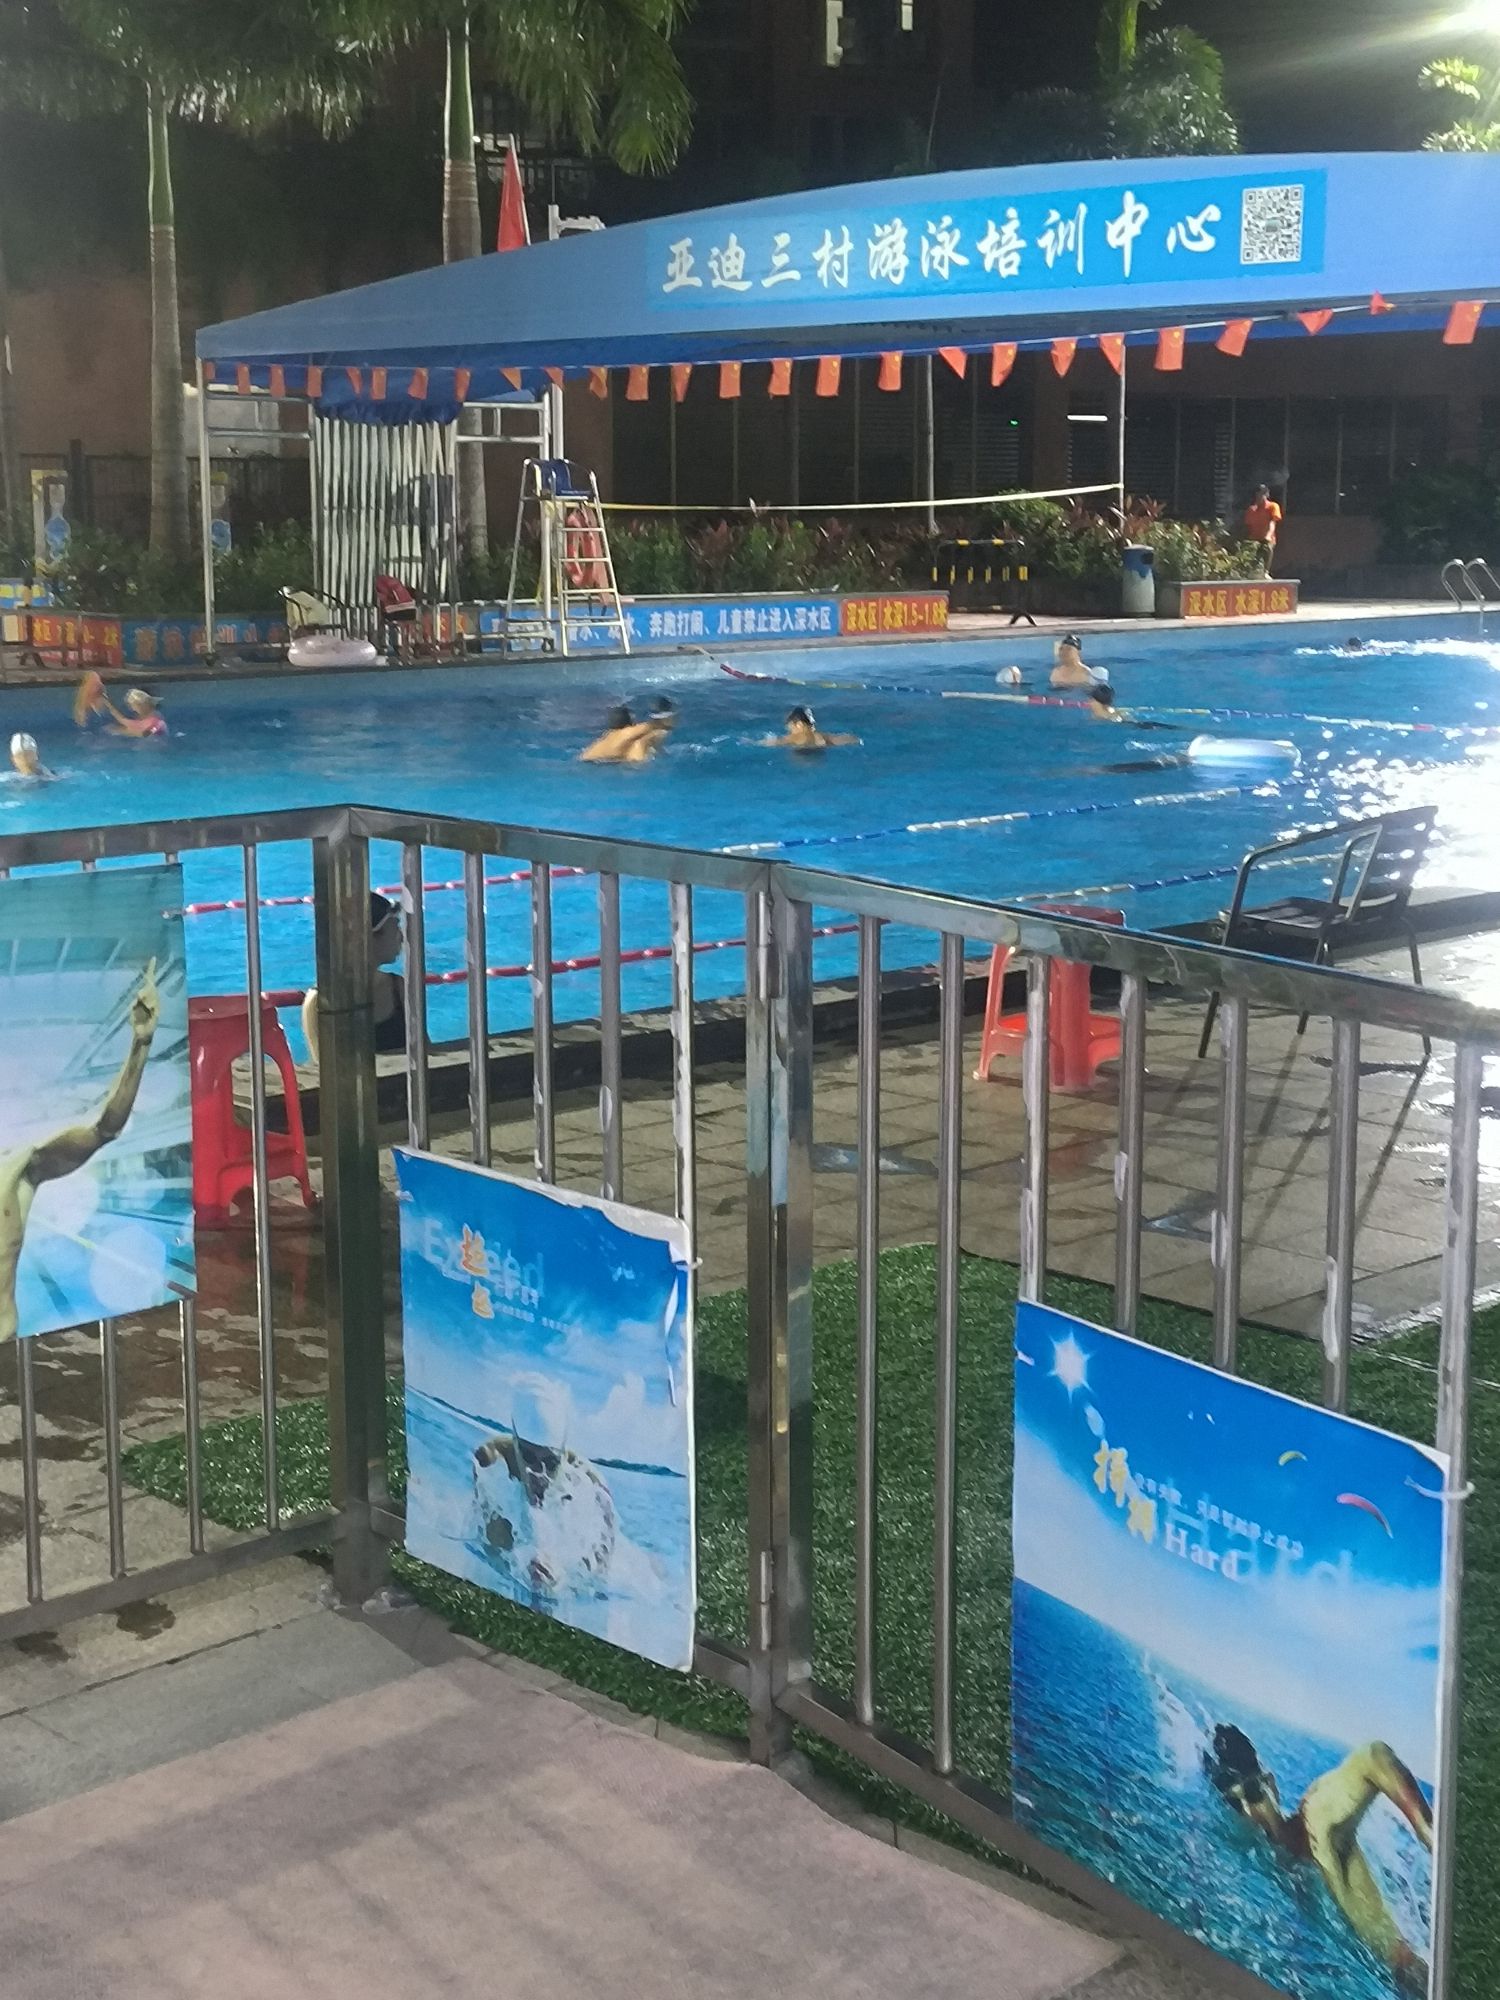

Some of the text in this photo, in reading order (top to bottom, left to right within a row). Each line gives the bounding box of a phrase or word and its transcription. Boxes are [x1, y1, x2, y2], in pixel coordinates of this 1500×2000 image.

[662, 190, 1221, 294] 亚迪三村游泳培训中心
[1165, 1521, 1240, 1583] Hard
